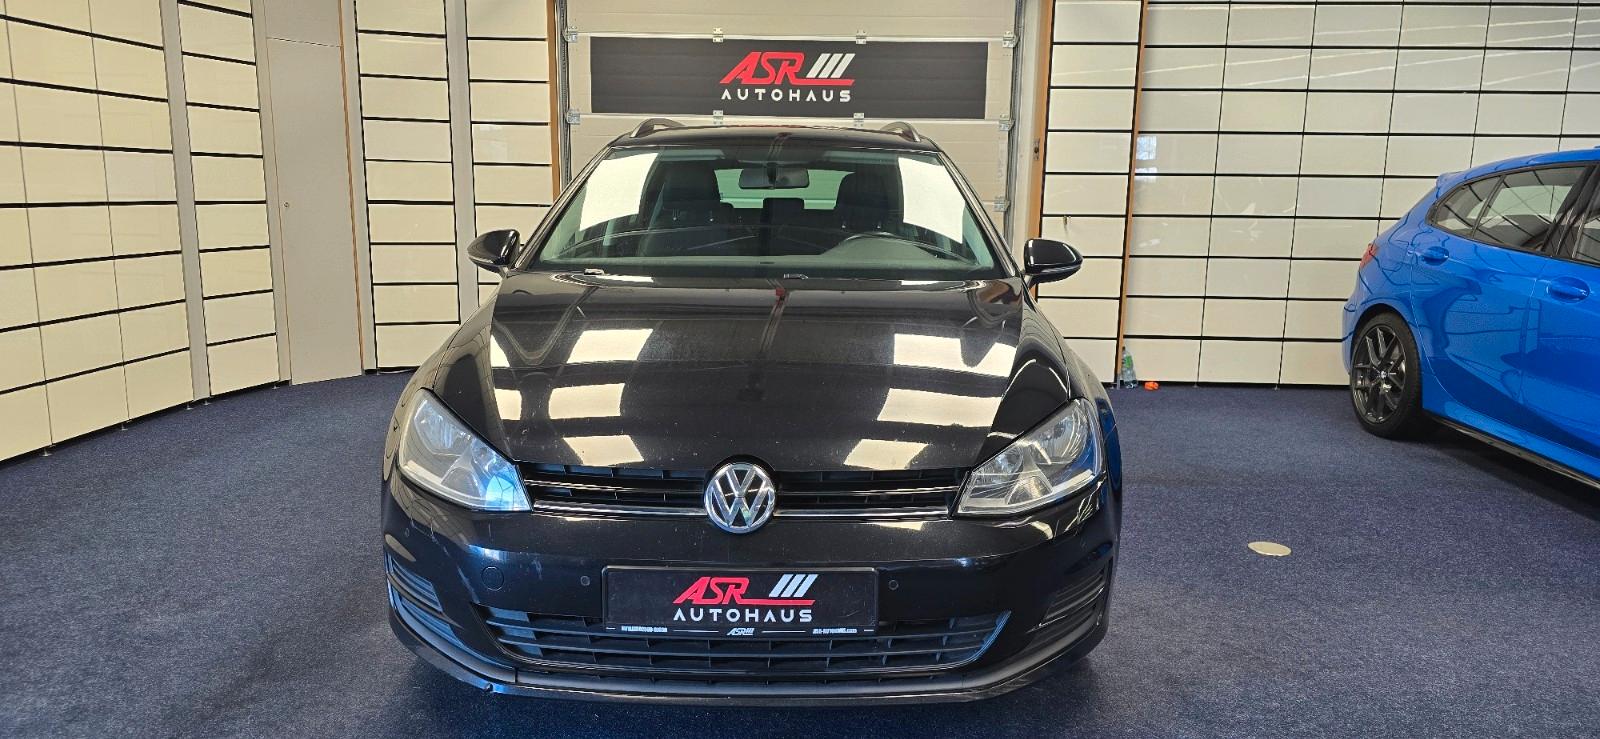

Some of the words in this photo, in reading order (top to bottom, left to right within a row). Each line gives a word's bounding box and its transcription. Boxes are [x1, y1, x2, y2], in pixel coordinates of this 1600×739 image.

[720, 52, 854, 85] ASR
[721, 89, 851, 102] AUTOHAUS
[705, 463, 775, 533] VW
[672, 577, 814, 605] ASR
[673, 608, 812, 622] AUTOHAUS
